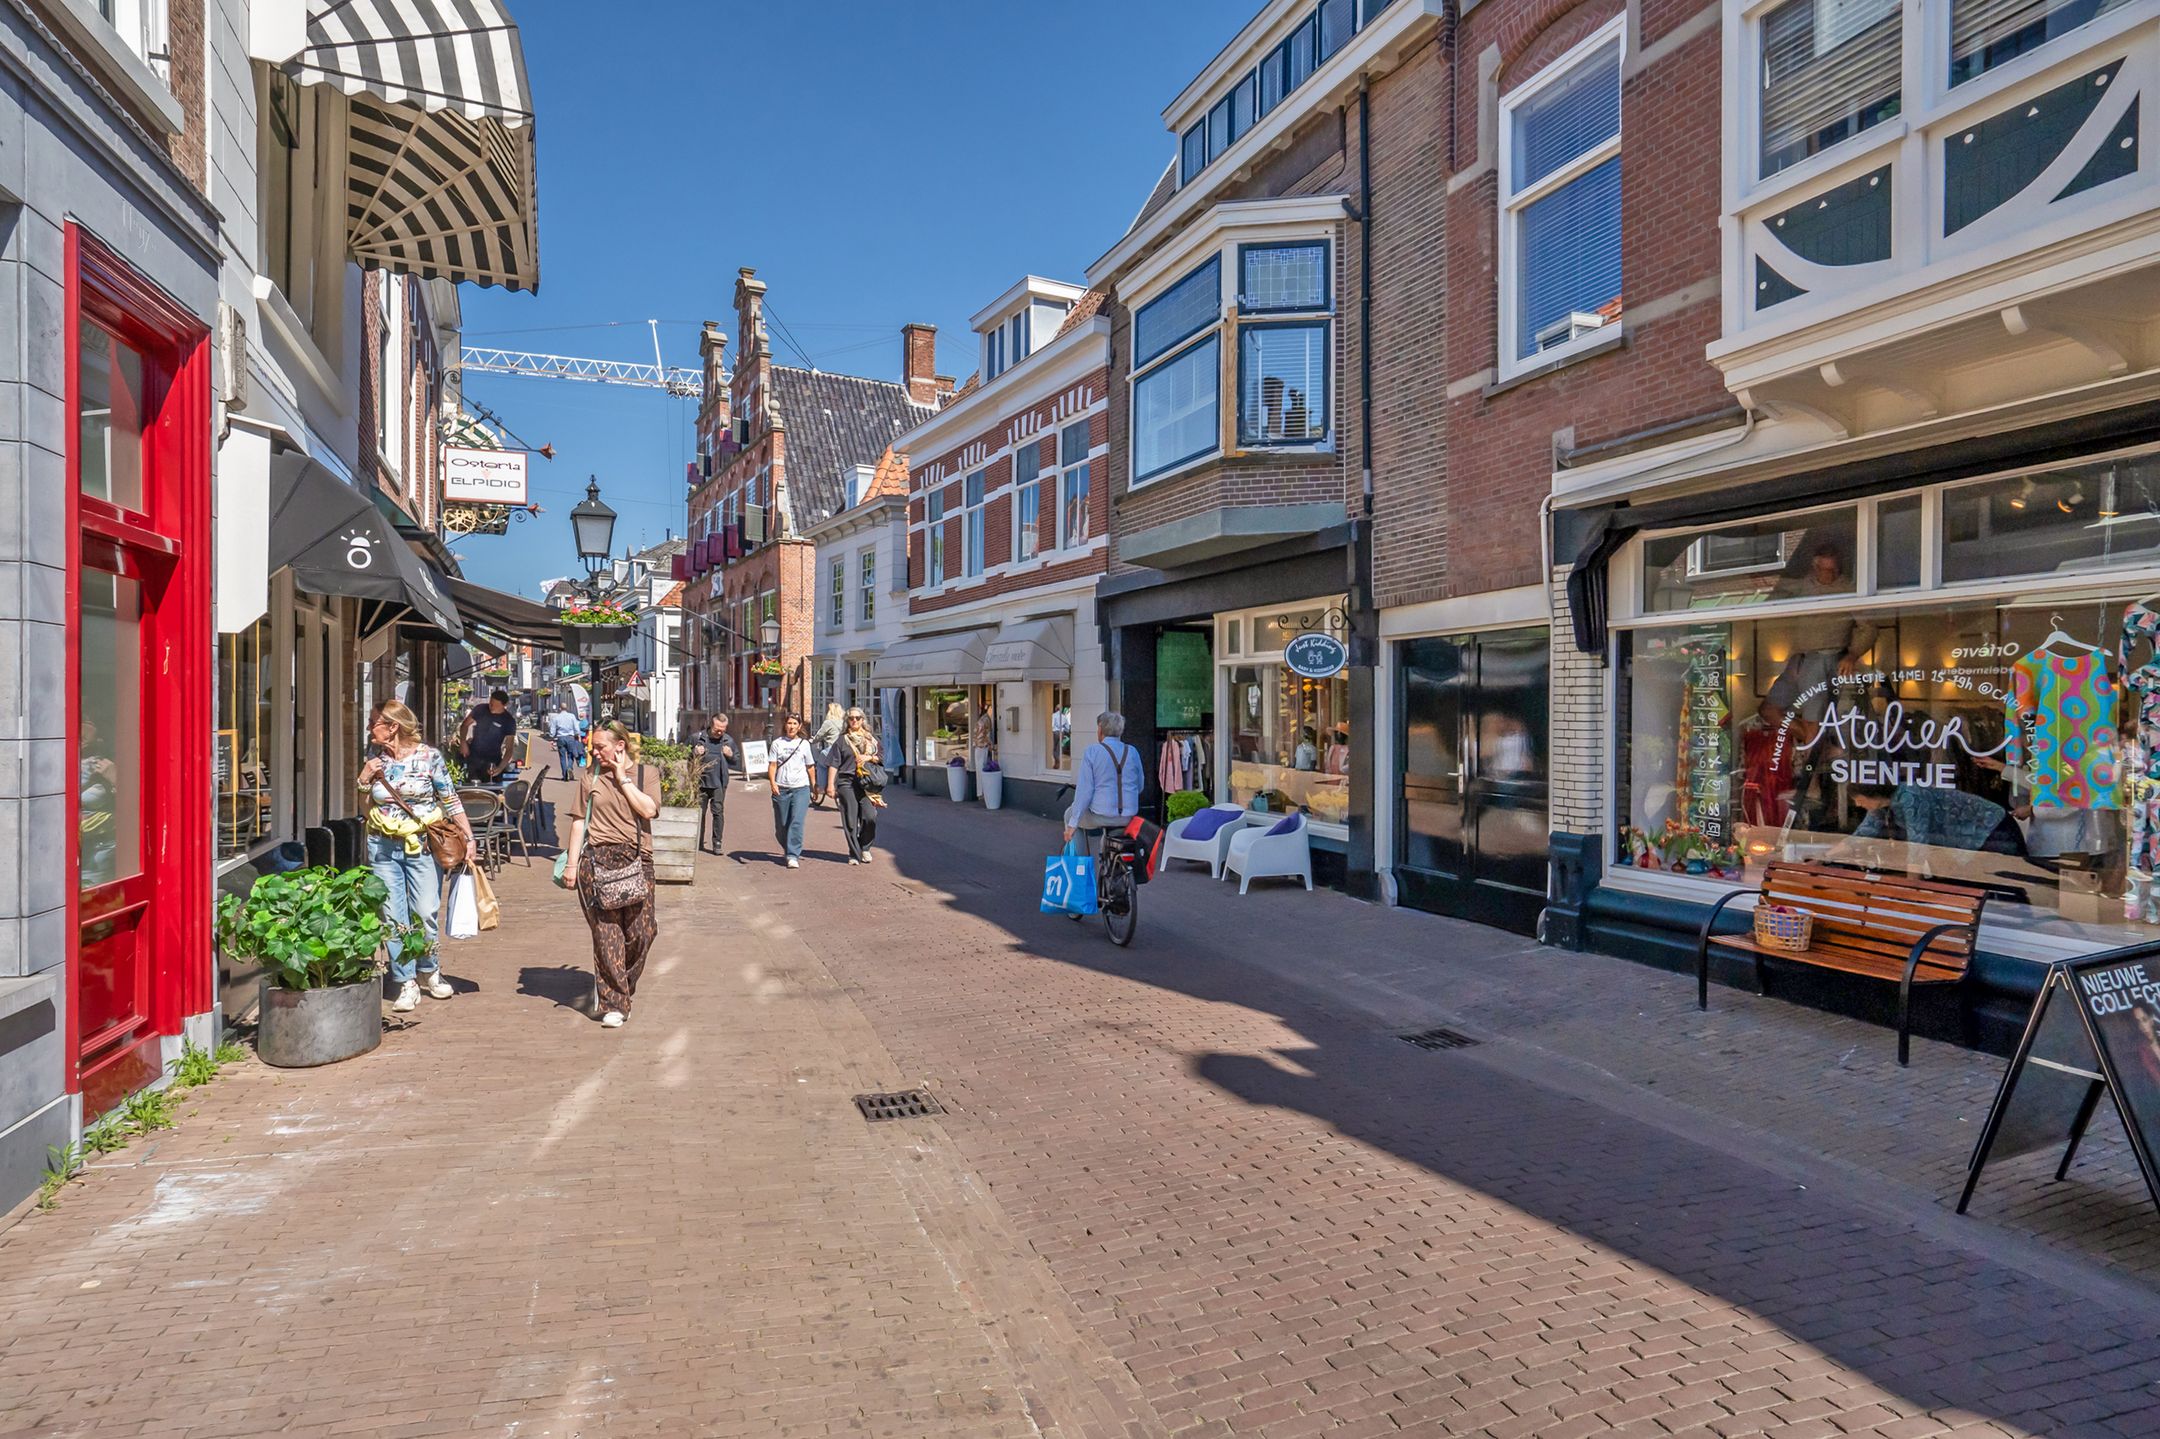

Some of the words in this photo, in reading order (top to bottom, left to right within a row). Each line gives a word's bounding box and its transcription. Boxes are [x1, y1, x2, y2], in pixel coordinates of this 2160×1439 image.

[451, 458, 521, 471] Osteria
[451, 477, 521, 488] ELPIDIO
[1295, 640, 1309, 653] Just
[1310, 638, 1337, 655] Kidding
[1698, 695, 1706, 707] 3
[1698, 713, 1706, 724] 4
[1769, 711, 1796, 772] LANCERING
[1792, 681, 1829, 709] NIEUWE
[1831, 671, 1886, 687] COLLECTIE
[1698, 732, 1706, 746] 5
[1699, 755, 1706, 769] 6
[1830, 759, 1957, 789] SIENTJE
[1699, 777, 1706, 791] 7
[1698, 800, 1706, 815] 8
[2080, 964, 2149, 996] NIEUWE
